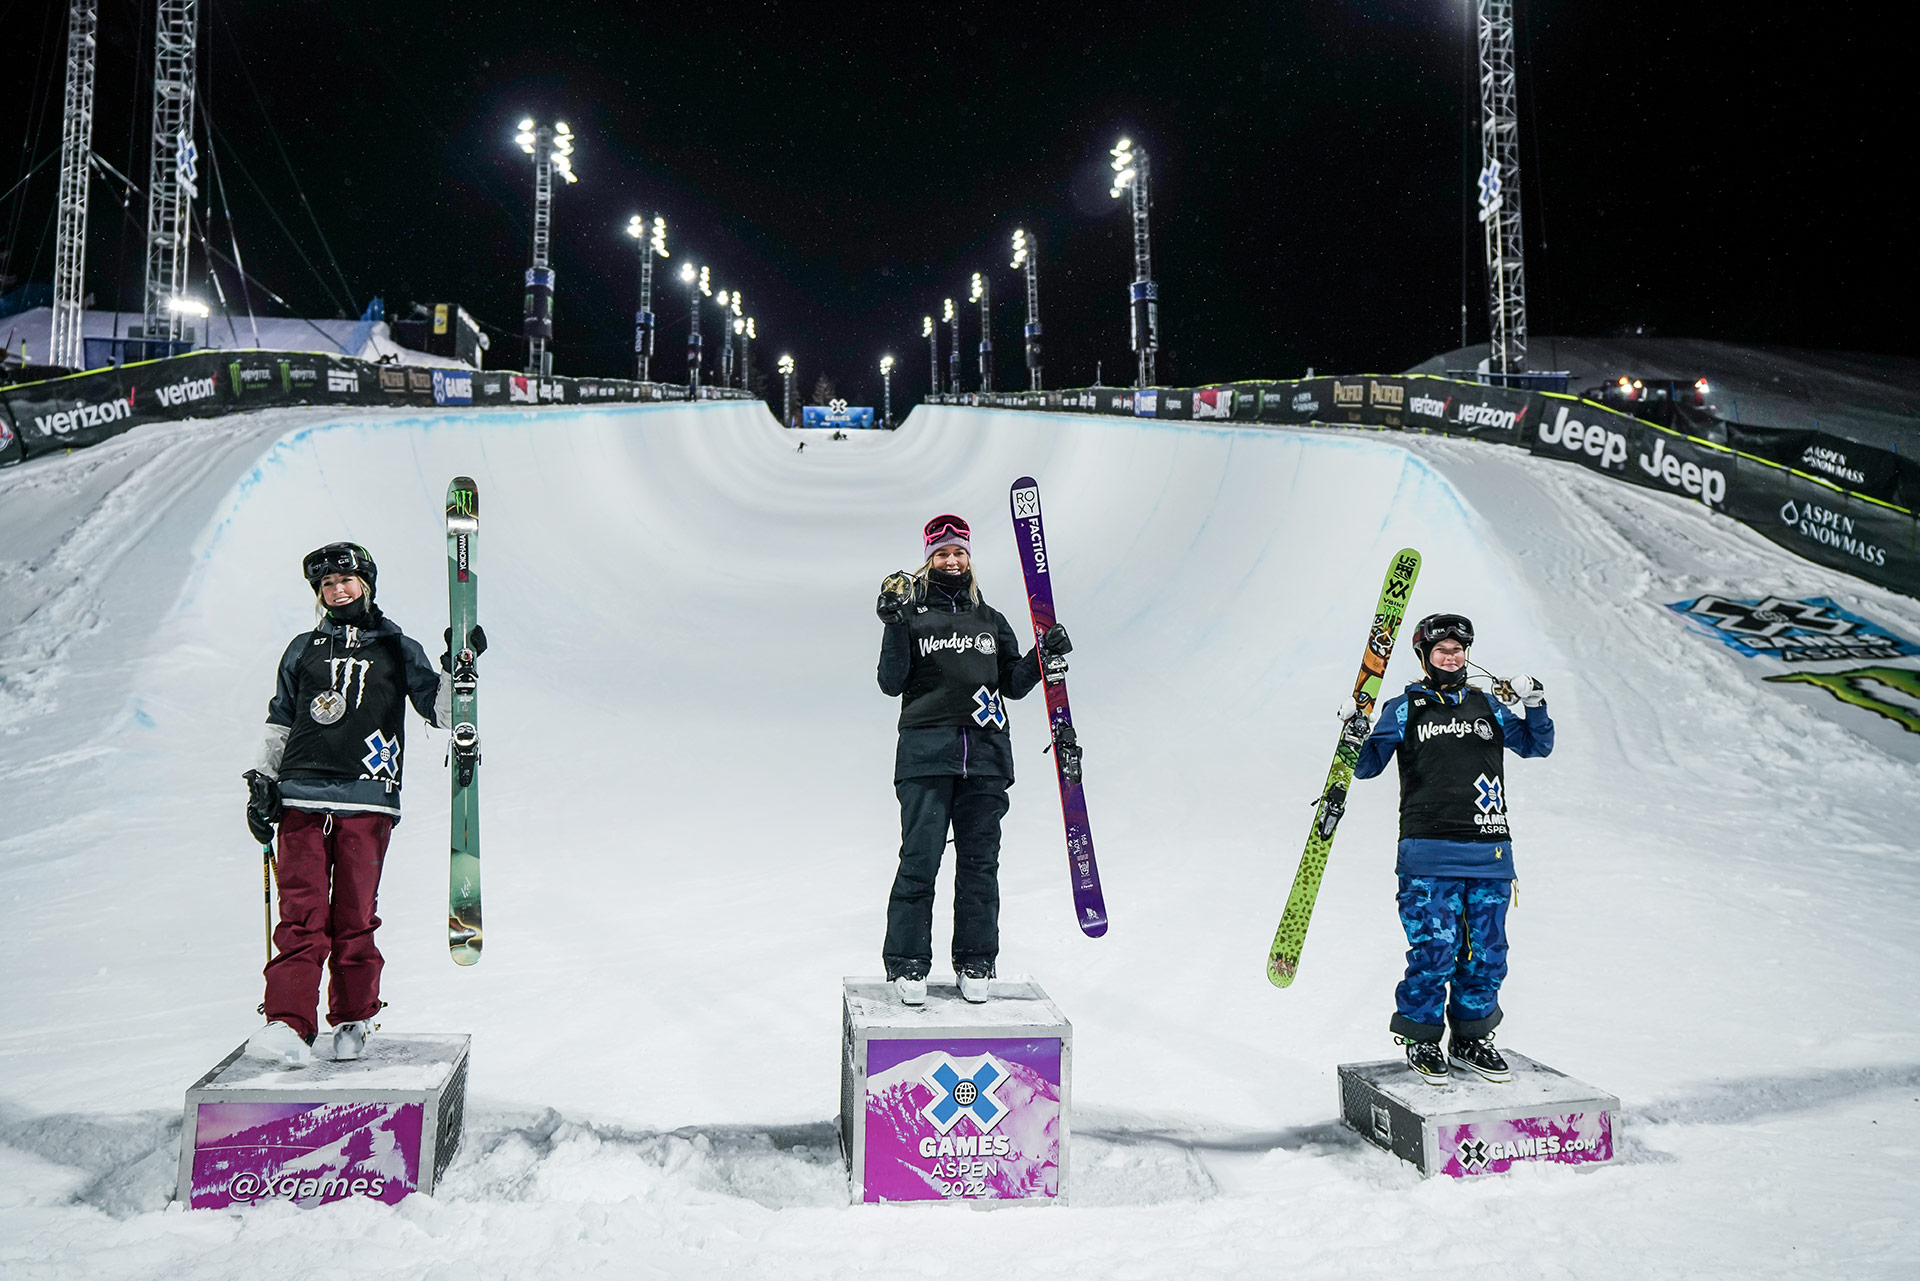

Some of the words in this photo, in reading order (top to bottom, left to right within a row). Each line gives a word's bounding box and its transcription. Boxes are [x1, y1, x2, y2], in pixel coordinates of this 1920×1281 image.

[156, 376, 215, 407] verizon
[35, 397, 132, 436] verizon
[1409, 393, 1445, 418] verizon
[1458, 402, 1516, 430] verizon
[1539, 407, 1628, 468] Jeep
[1814, 446, 1847, 466] ASPEN
[1640, 438, 1726, 505] Jeep
[1801, 502, 1855, 535] ASPEN
[1028, 517, 1047, 574] FACTION
[1799, 519, 1887, 567] SNOWMASS
[1399, 554, 1418, 567] US
[918, 632, 973, 657] Wendy's
[1738, 634, 1895, 650] GAMES
[1417, 717, 1472, 742] Wendy's
[1473, 813, 1507, 826] GAME
[919, 1135, 1011, 1159] GAMES
[930, 1161, 999, 1179] ASPEN
[229, 1172, 386, 1203] @xgames
[940, 1181, 986, 1197] 2022
